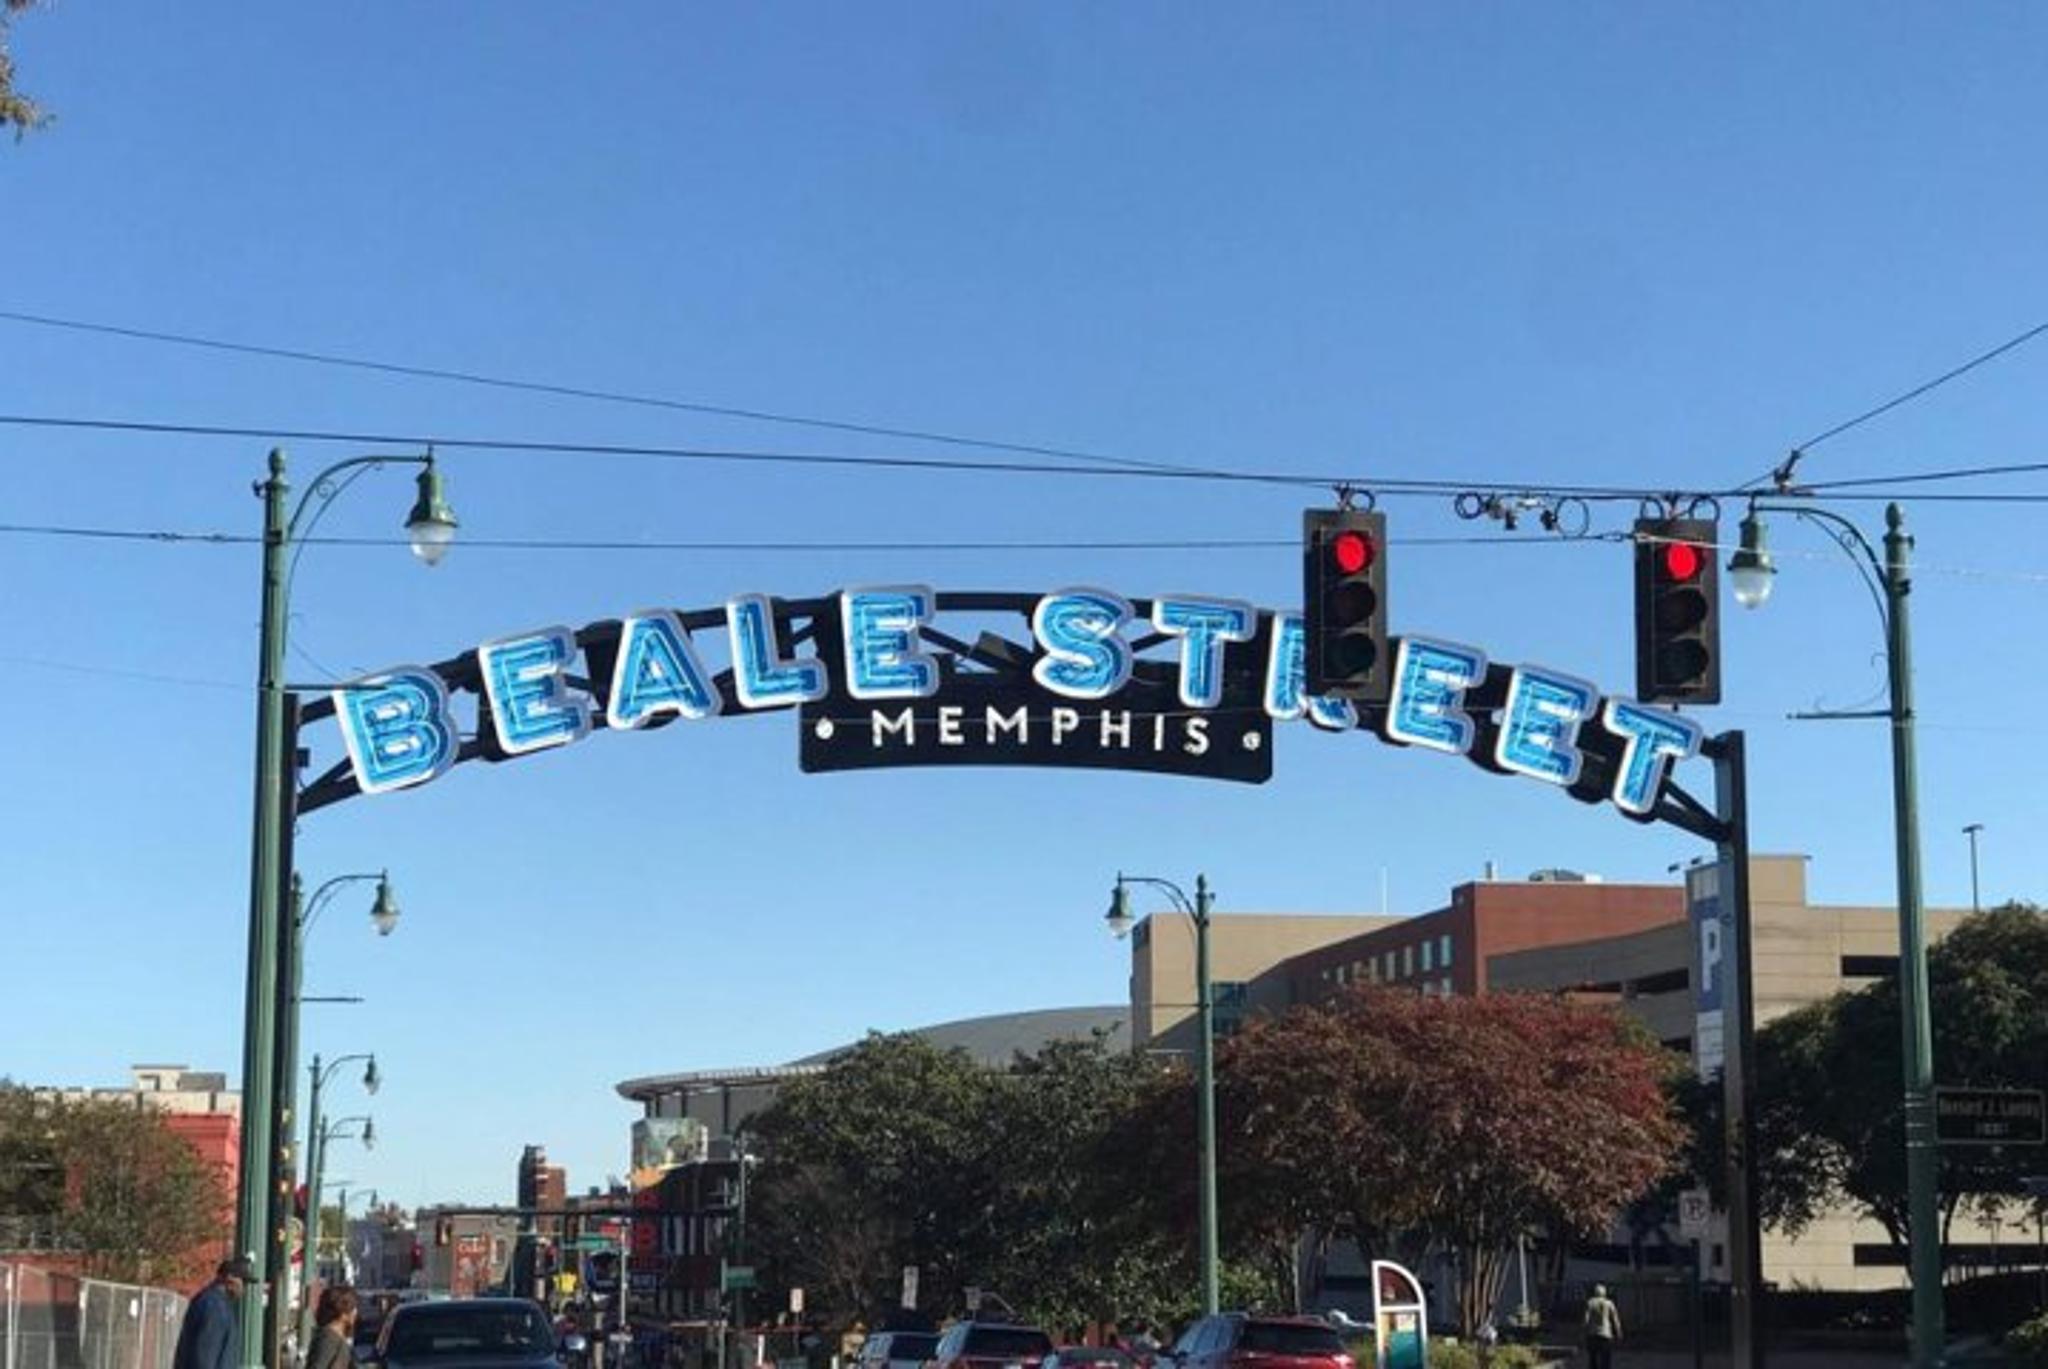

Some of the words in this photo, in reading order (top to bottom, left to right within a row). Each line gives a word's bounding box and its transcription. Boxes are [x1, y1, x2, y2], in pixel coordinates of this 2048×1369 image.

[334, 584, 938, 795] BEALE
[871, 705, 1210, 756] MEMPHIS
[1702, 918, 1722, 991] P
